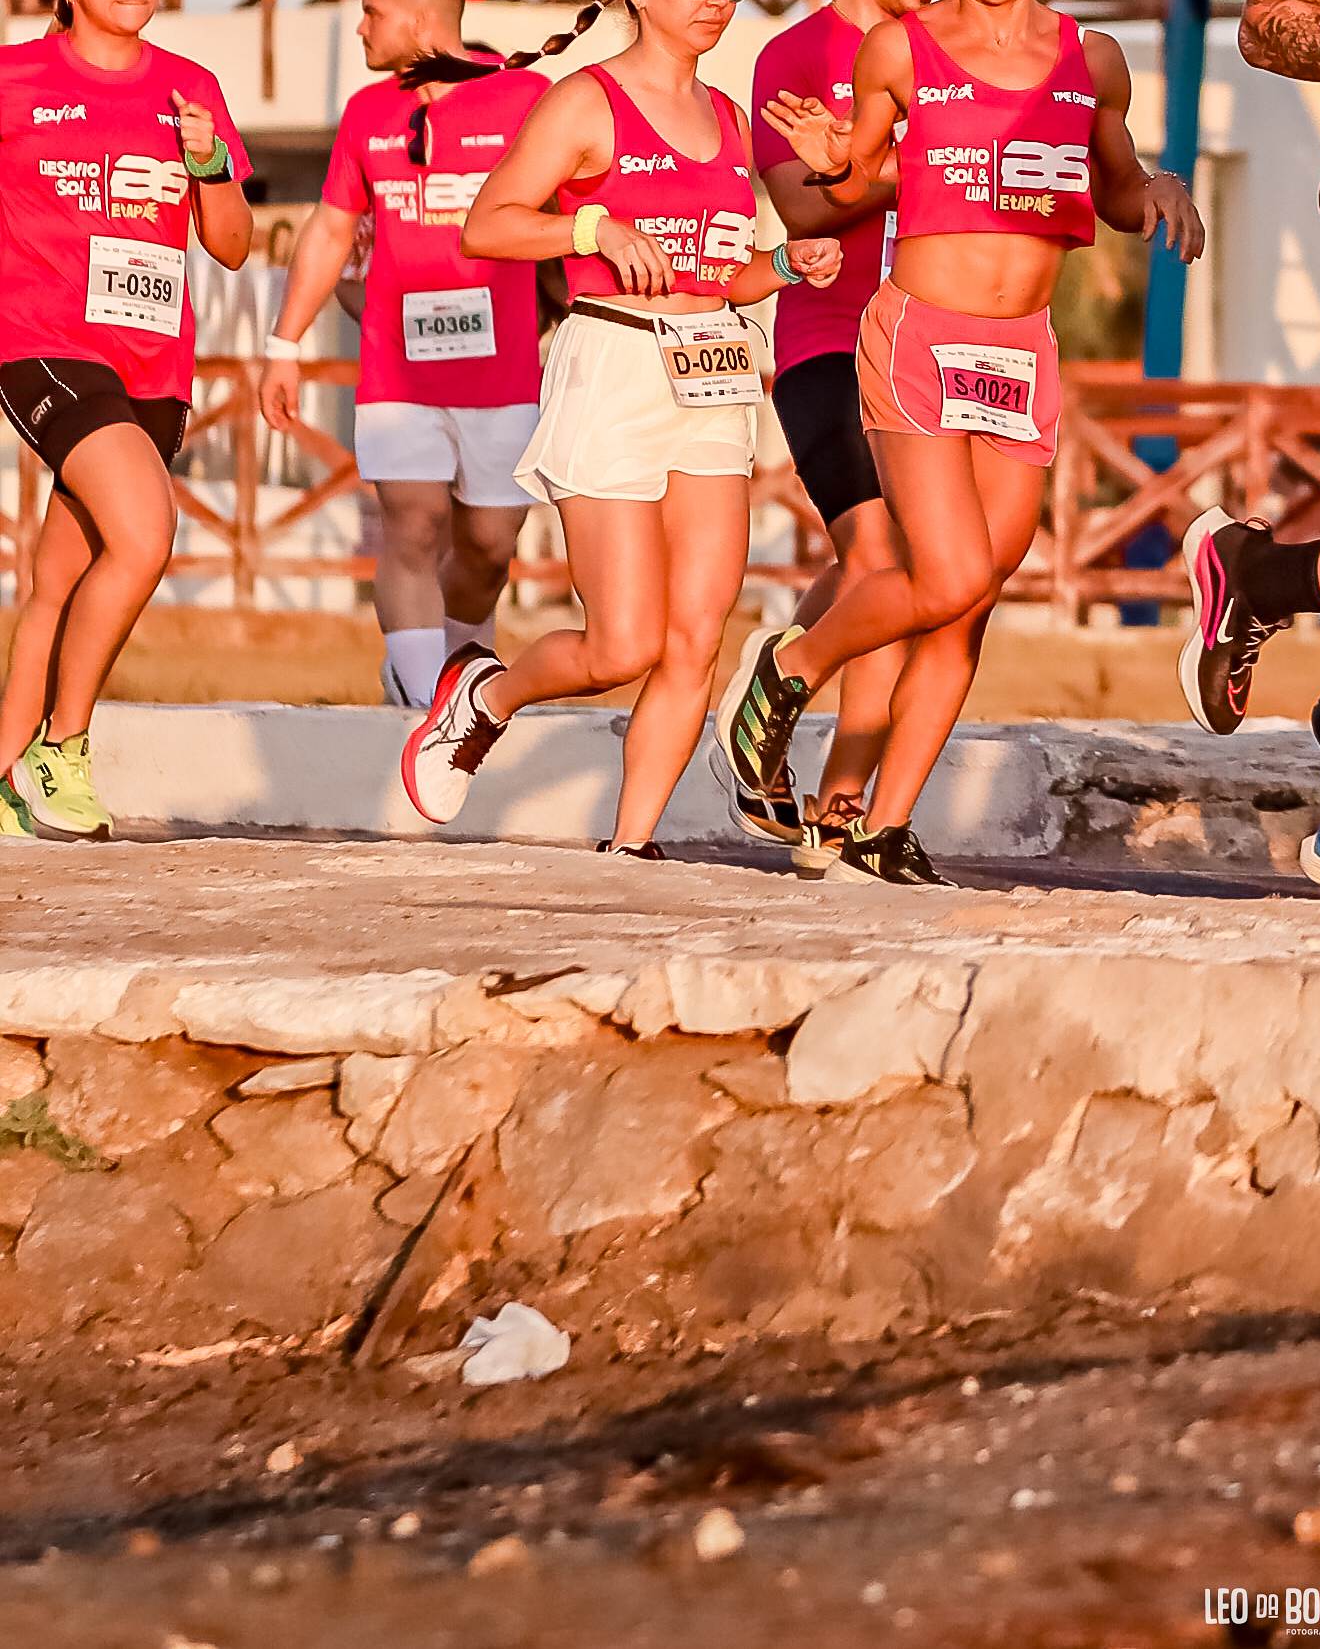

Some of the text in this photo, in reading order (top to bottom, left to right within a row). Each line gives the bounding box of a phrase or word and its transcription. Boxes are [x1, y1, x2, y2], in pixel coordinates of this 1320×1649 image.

[944, 166, 975, 185] SOL
[103, 270, 172, 302] T-0359
[414, 314, 481, 336] T-0365
[673, 347, 749, 375] D-0206
[953, 373, 1021, 409] S-0021
